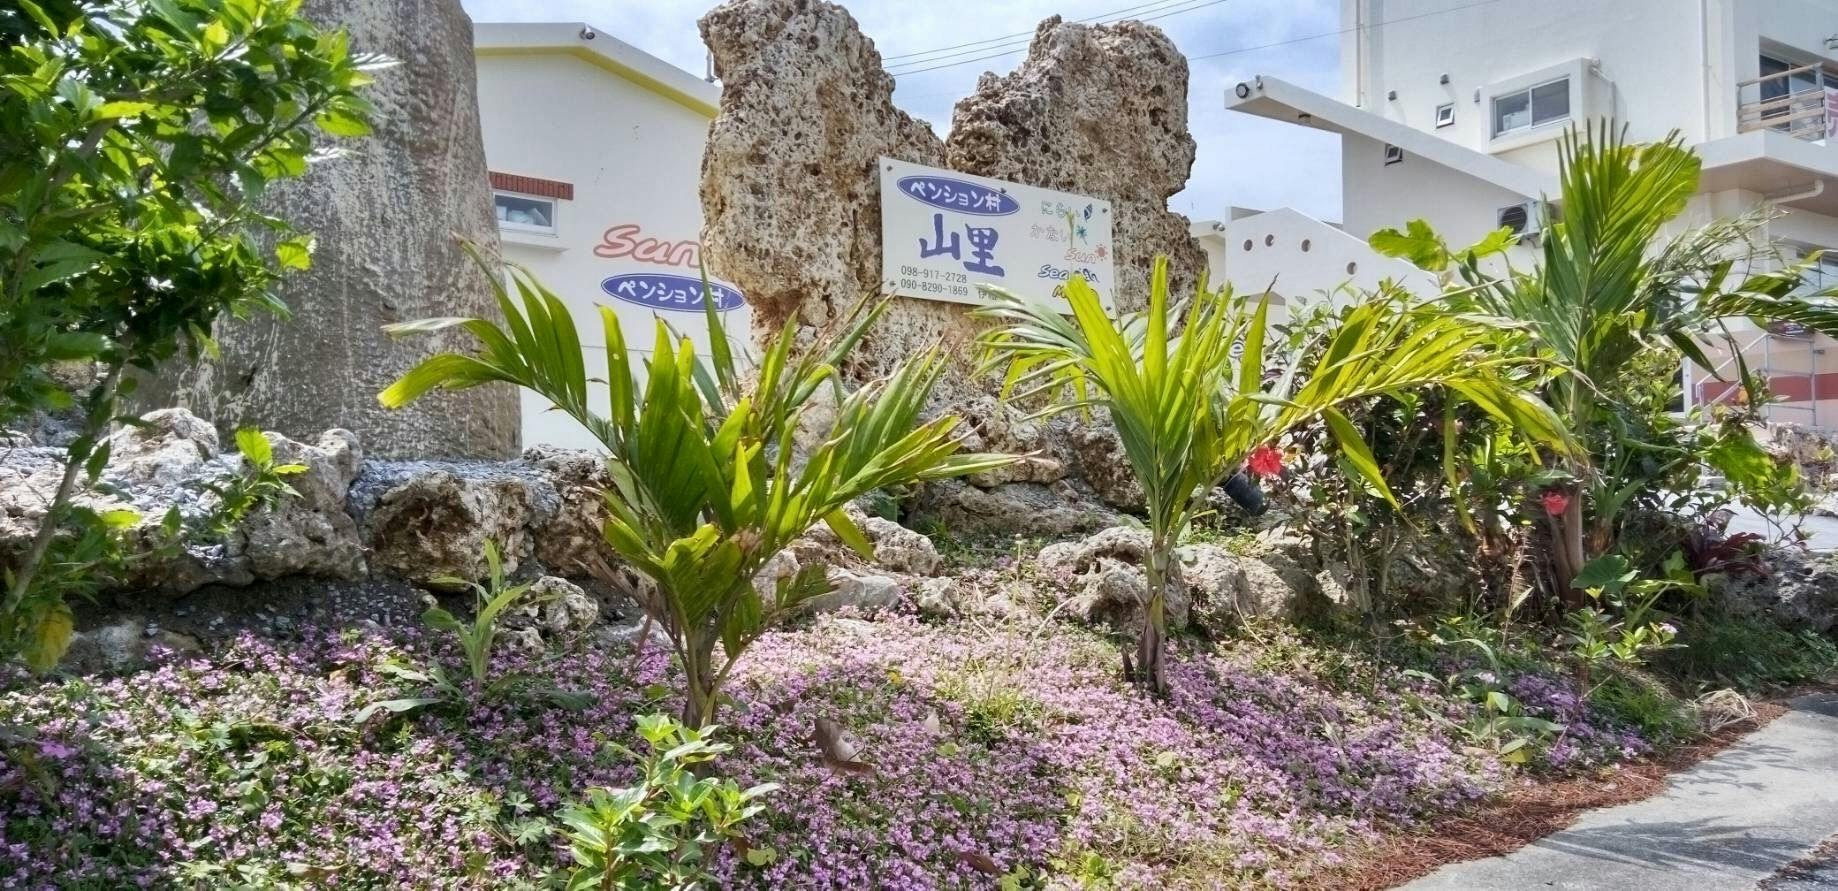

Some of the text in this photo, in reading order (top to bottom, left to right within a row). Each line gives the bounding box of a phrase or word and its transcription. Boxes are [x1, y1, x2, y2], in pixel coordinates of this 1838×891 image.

[911, 181, 1001, 212] ペンション村
[593, 224, 702, 268] Sun
[919, 213, 1006, 278] 山里
[1064, 248, 1097, 264] Sun
[901, 265, 968, 283] 098-917-2728
[1038, 264, 1069, 280] Sea
[900, 278, 969, 297] 090-8290-1869
